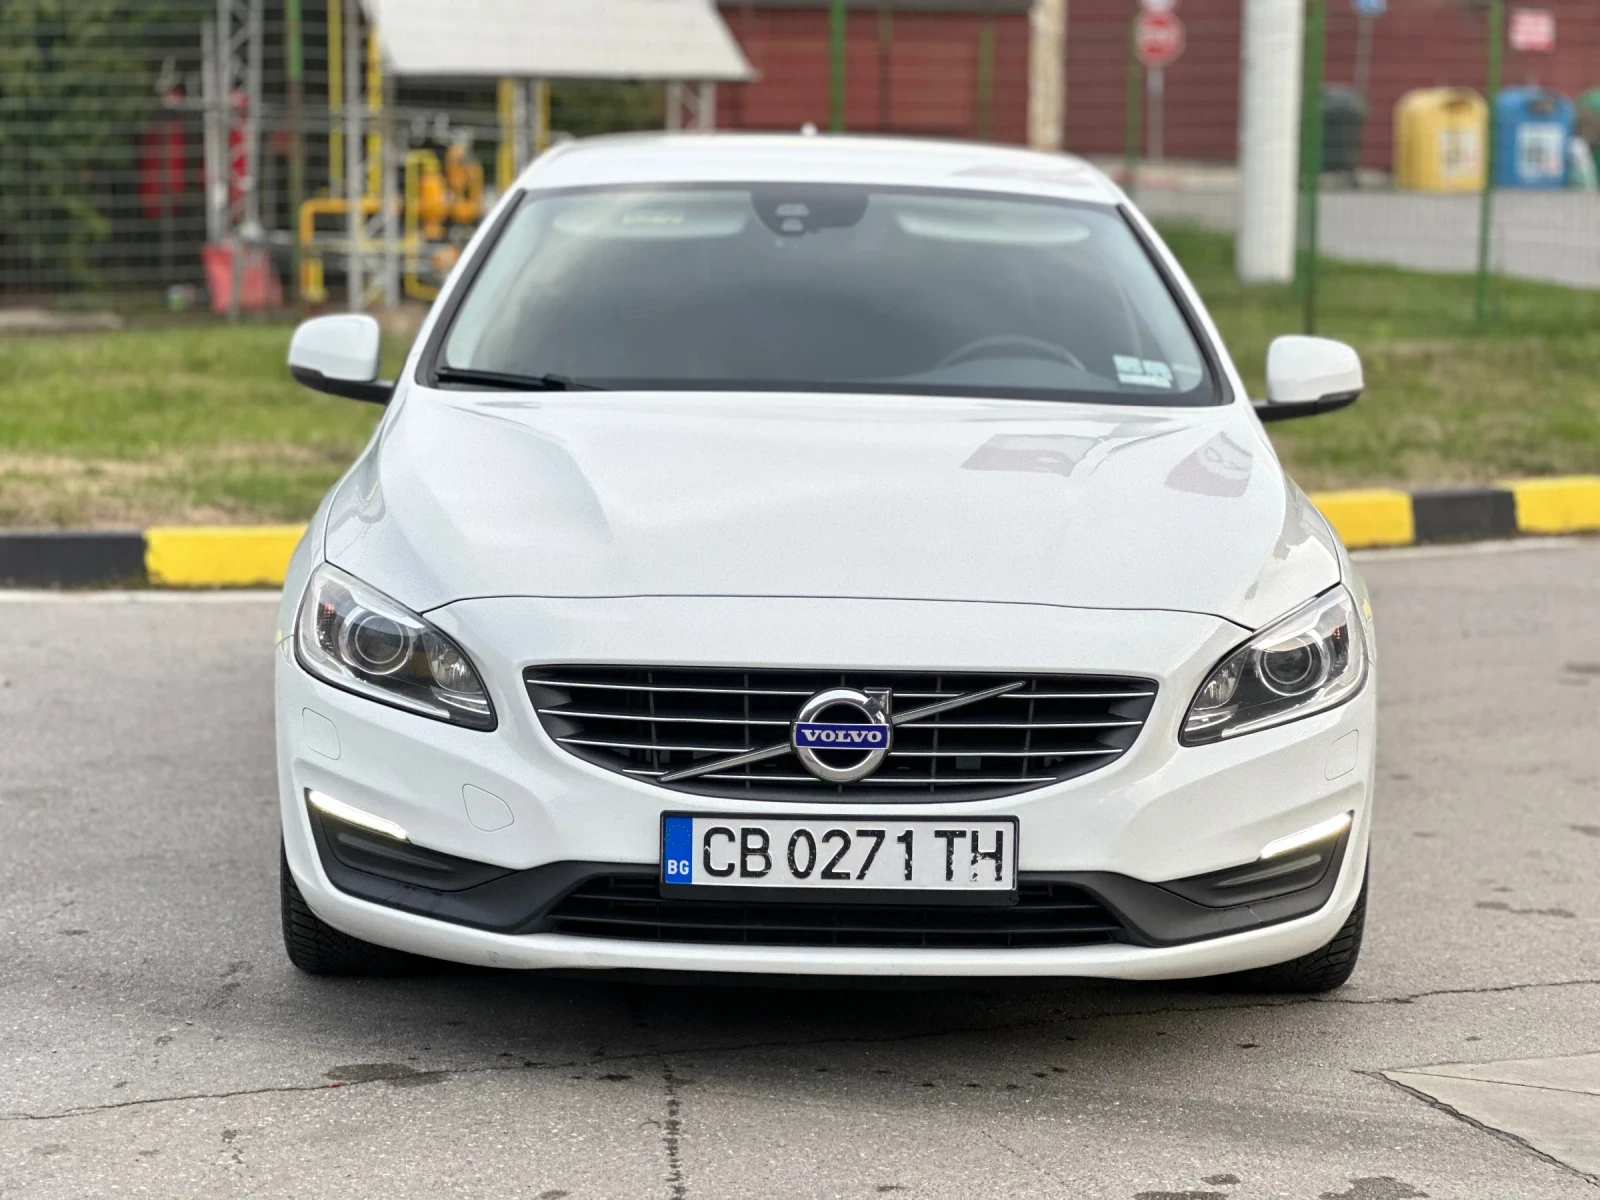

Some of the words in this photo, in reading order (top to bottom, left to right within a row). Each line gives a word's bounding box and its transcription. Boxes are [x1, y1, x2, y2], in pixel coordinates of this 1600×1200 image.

[801, 729, 882, 743] VOLVO
[702, 826, 773, 878] CB
[786, 828, 914, 881] 0271
[934, 829, 1004, 882] TH
[667, 859, 690, 875] BG
